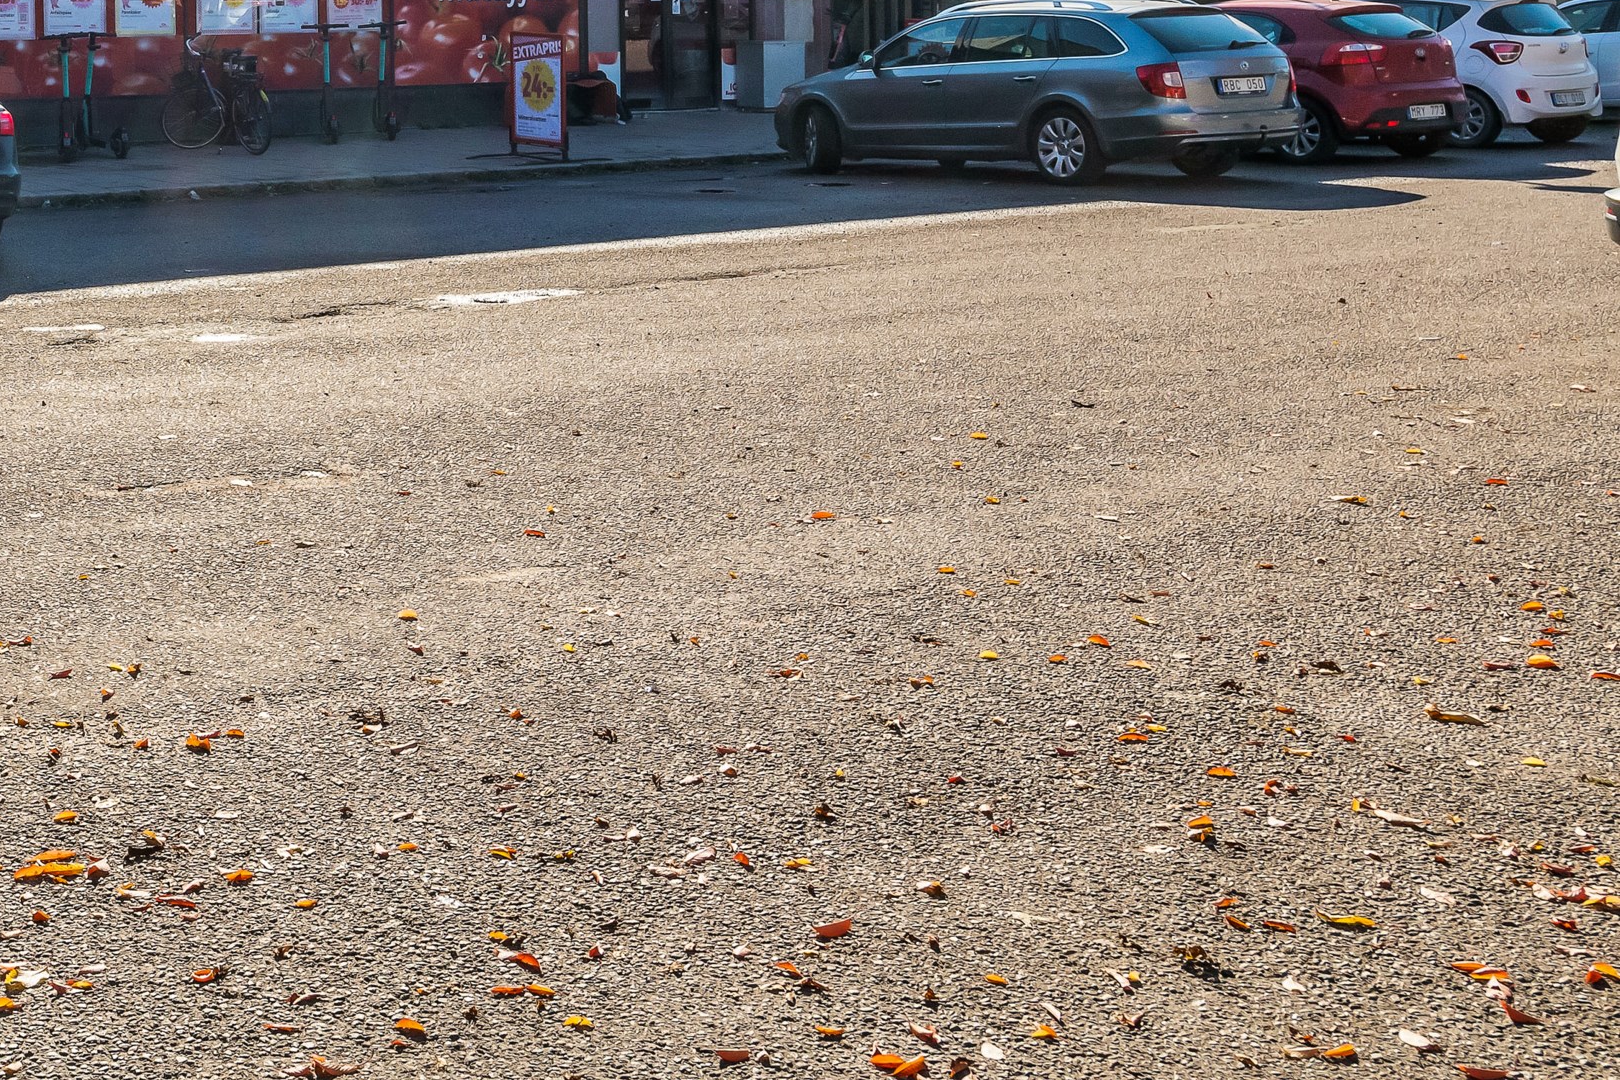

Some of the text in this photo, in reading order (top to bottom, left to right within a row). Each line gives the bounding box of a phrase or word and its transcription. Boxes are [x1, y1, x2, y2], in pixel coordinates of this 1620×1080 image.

[1223, 78, 1263, 91] RBC 050
[1411, 105, 1445, 118] MRY 773
